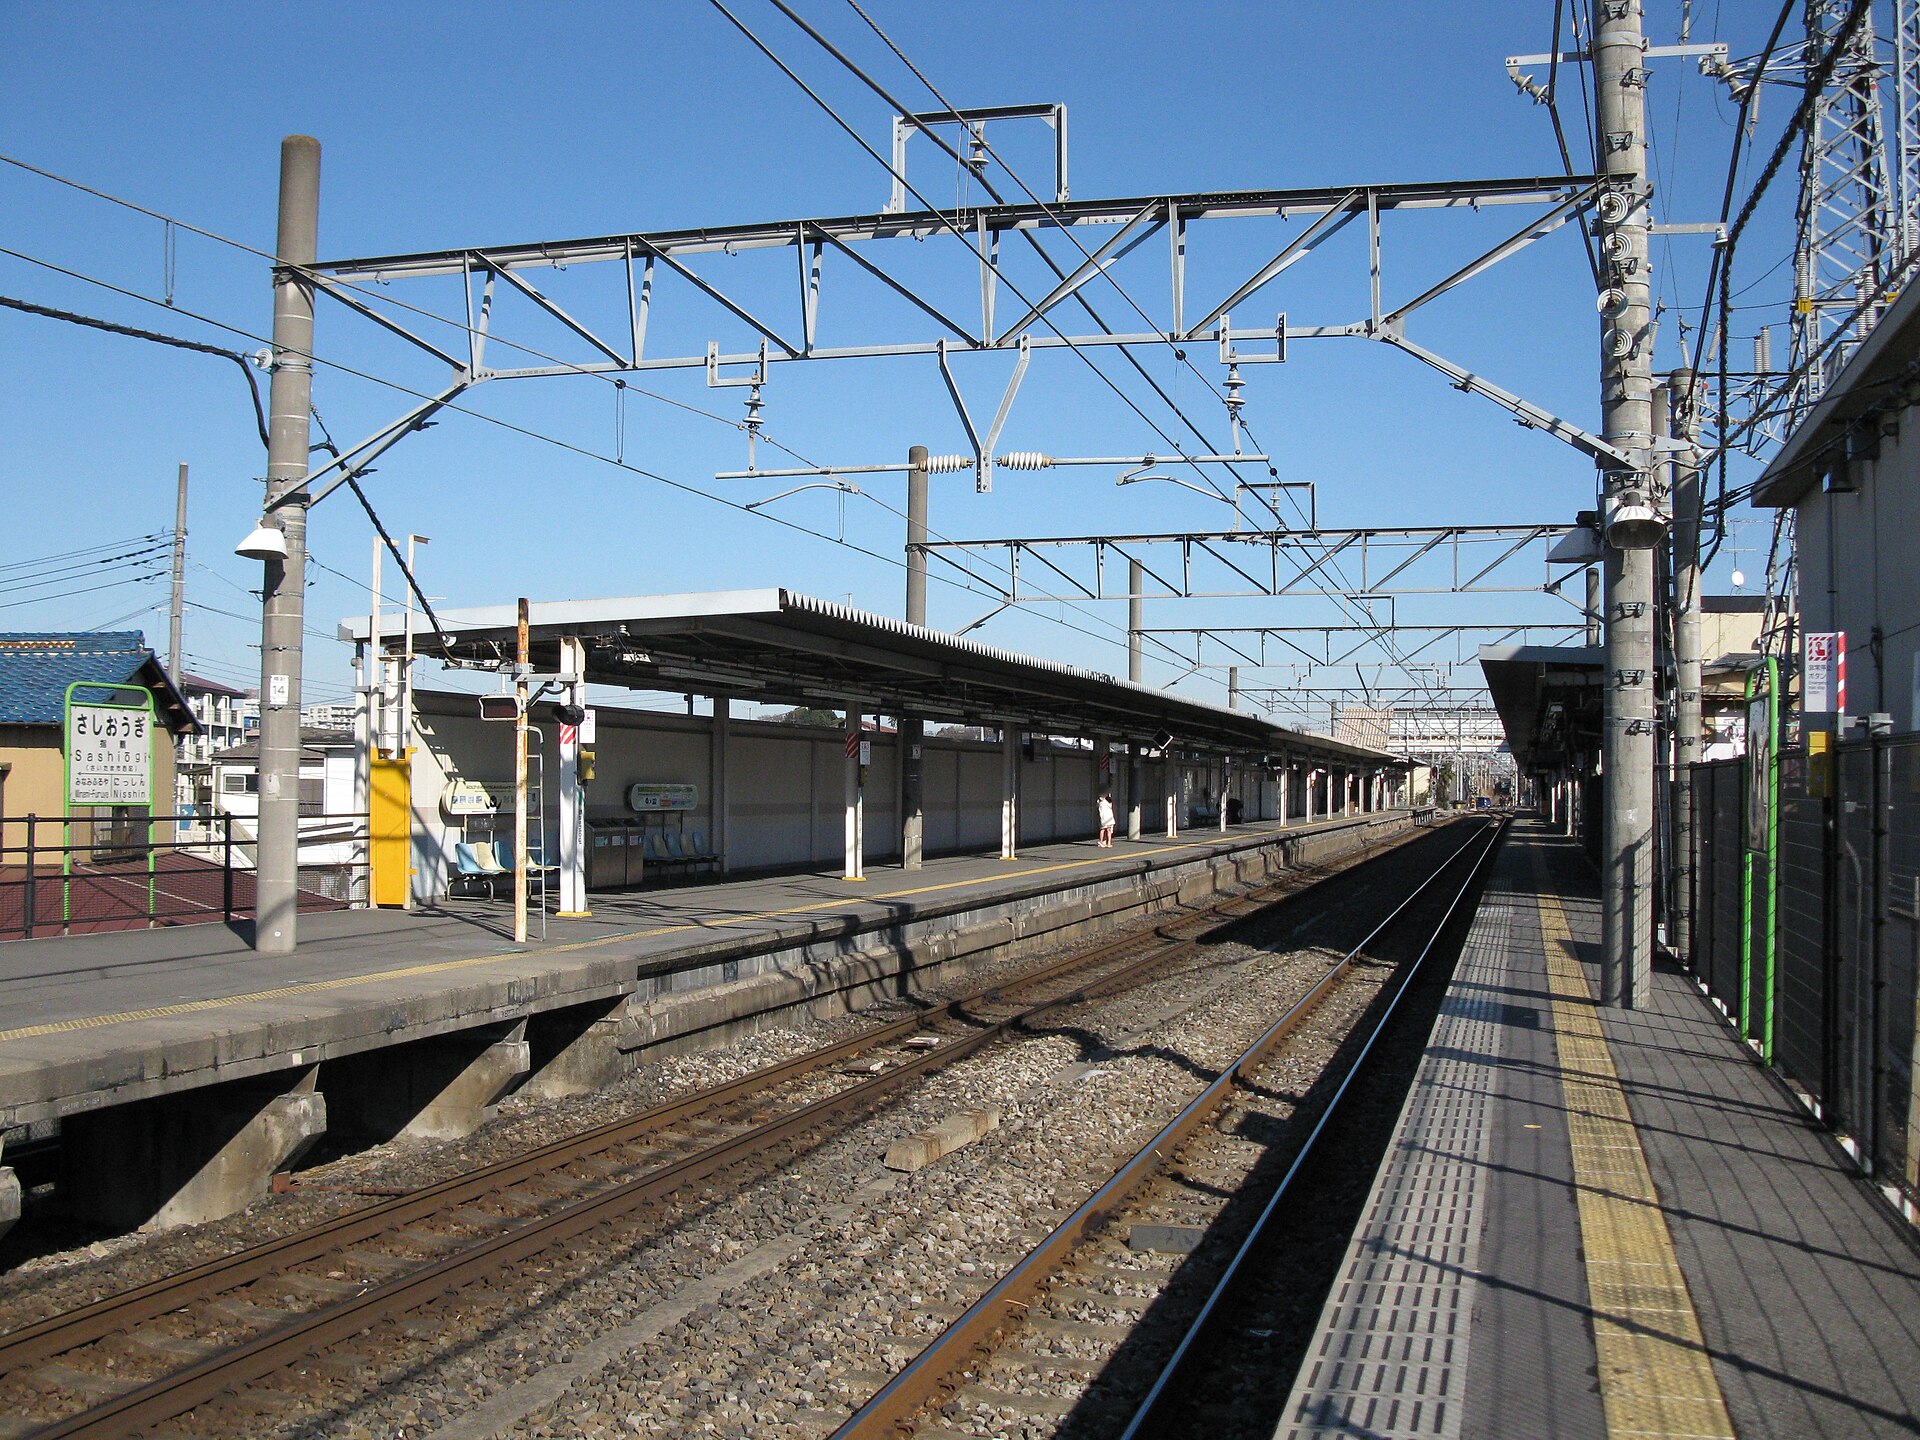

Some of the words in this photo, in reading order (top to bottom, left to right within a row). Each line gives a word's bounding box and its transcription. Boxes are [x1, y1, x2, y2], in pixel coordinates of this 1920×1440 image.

[273, 686, 285, 695] 14
[77, 713, 146, 738] さしおうぎ
[114, 777, 145, 786] にっしん
[114, 790, 145, 798] Nisshin
